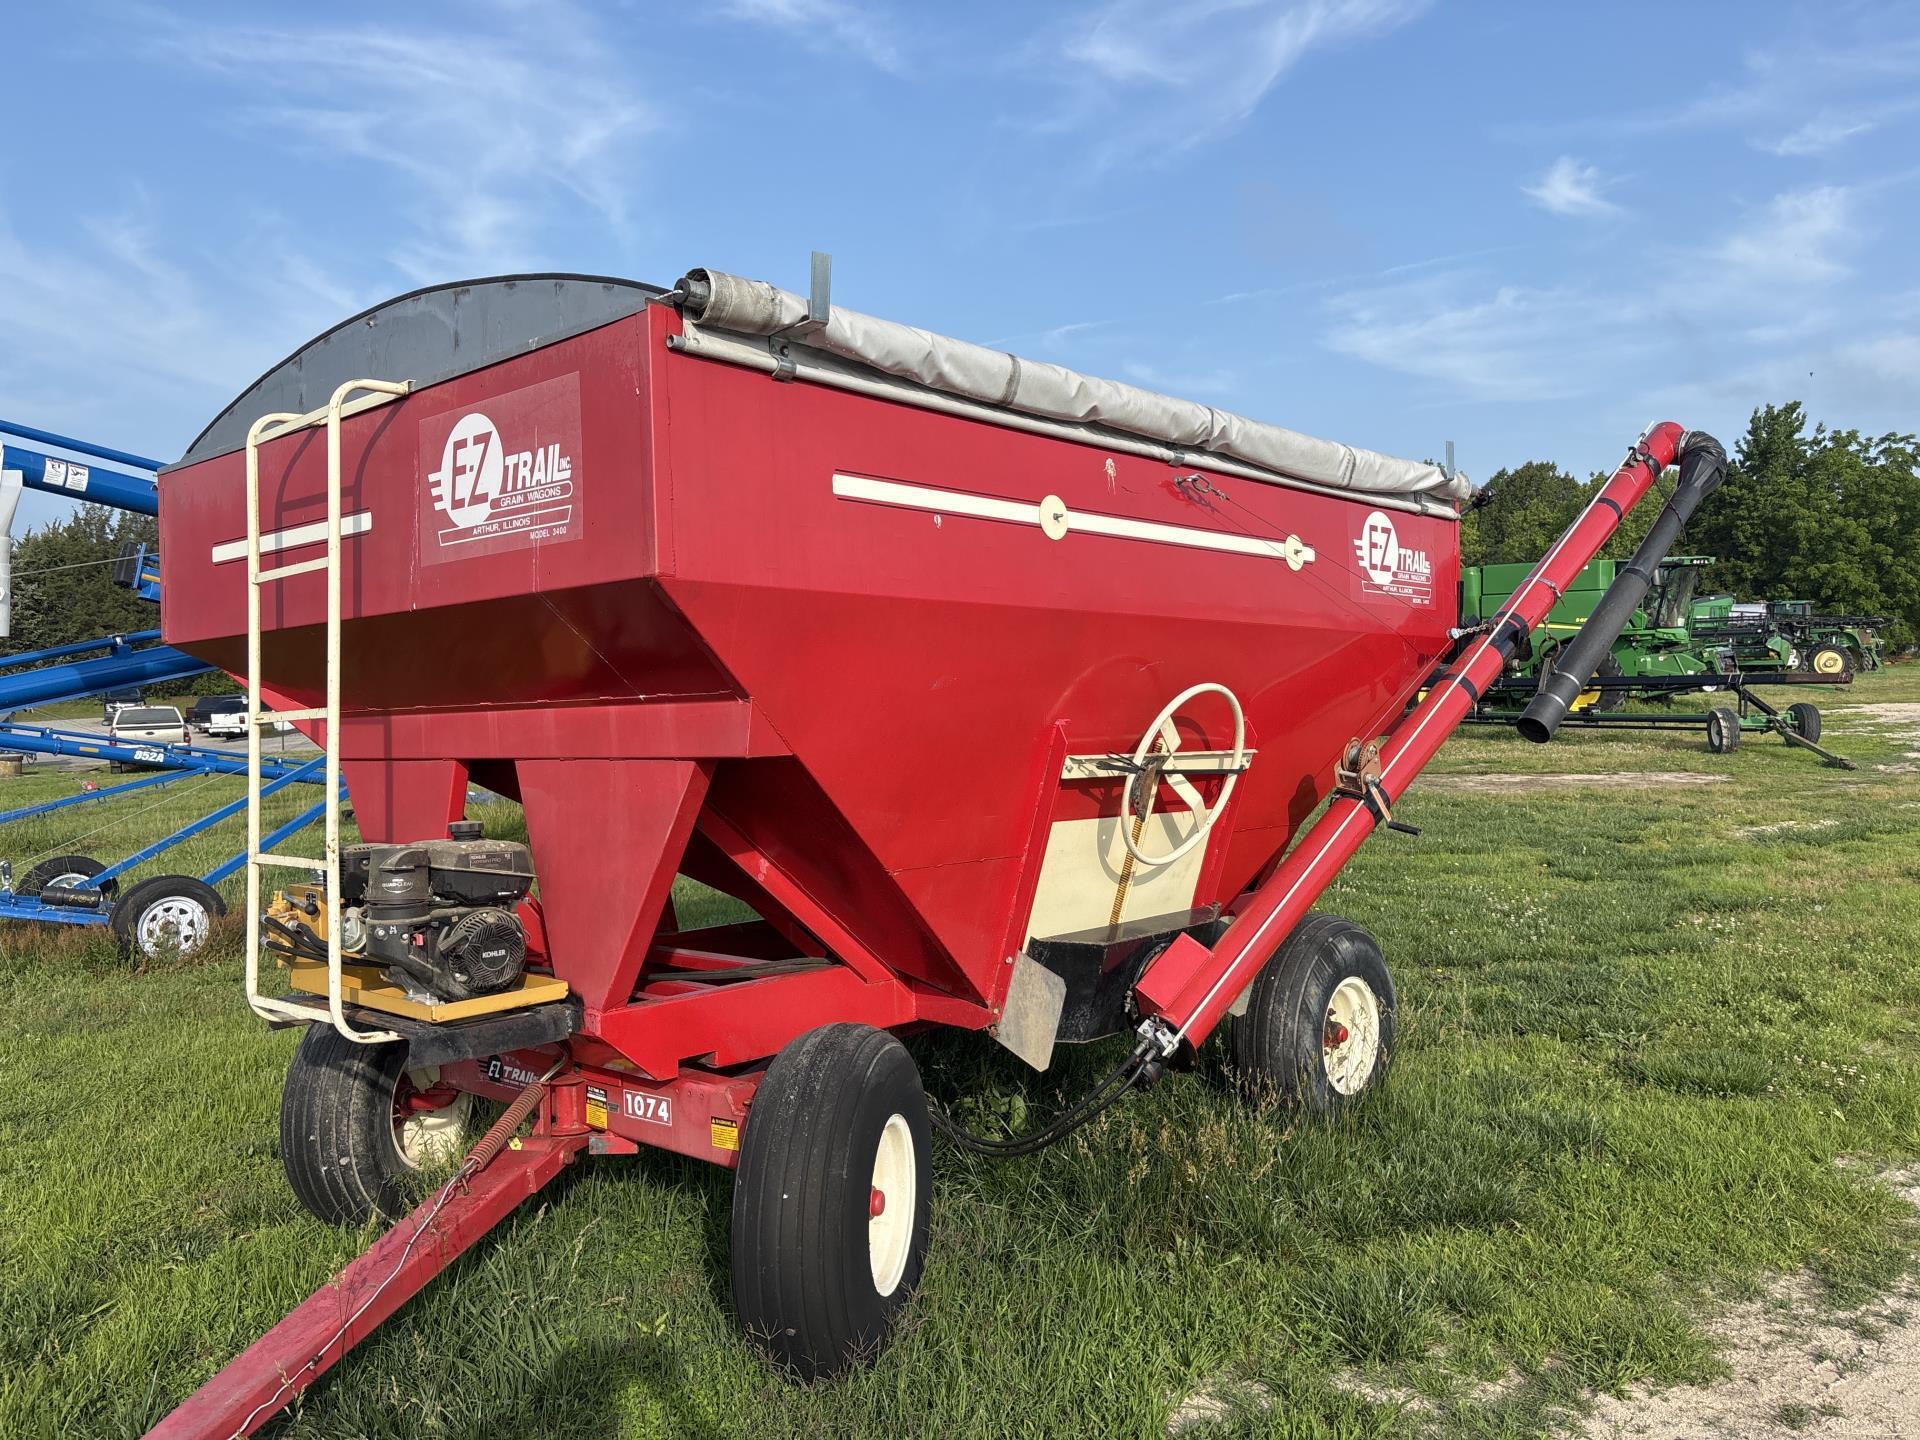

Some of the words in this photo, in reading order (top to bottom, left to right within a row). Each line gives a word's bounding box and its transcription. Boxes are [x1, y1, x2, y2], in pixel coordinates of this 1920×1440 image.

[505, 444, 571, 491] TRAIL
[560, 456, 571, 470] INC.
[500, 494, 524, 507] GRAIN
[527, 486, 561, 501] WAGONS
[473, 523, 500, 535] ARTHUR,
[503, 517, 531, 529] ILLINOIS
[530, 528, 550, 540] MODEL
[552, 526, 567, 536] 3400
[1399, 548, 1430, 573] TRAIL
[482, 949, 506, 958] KOHLER
[626, 1093, 669, 1122] 1074
